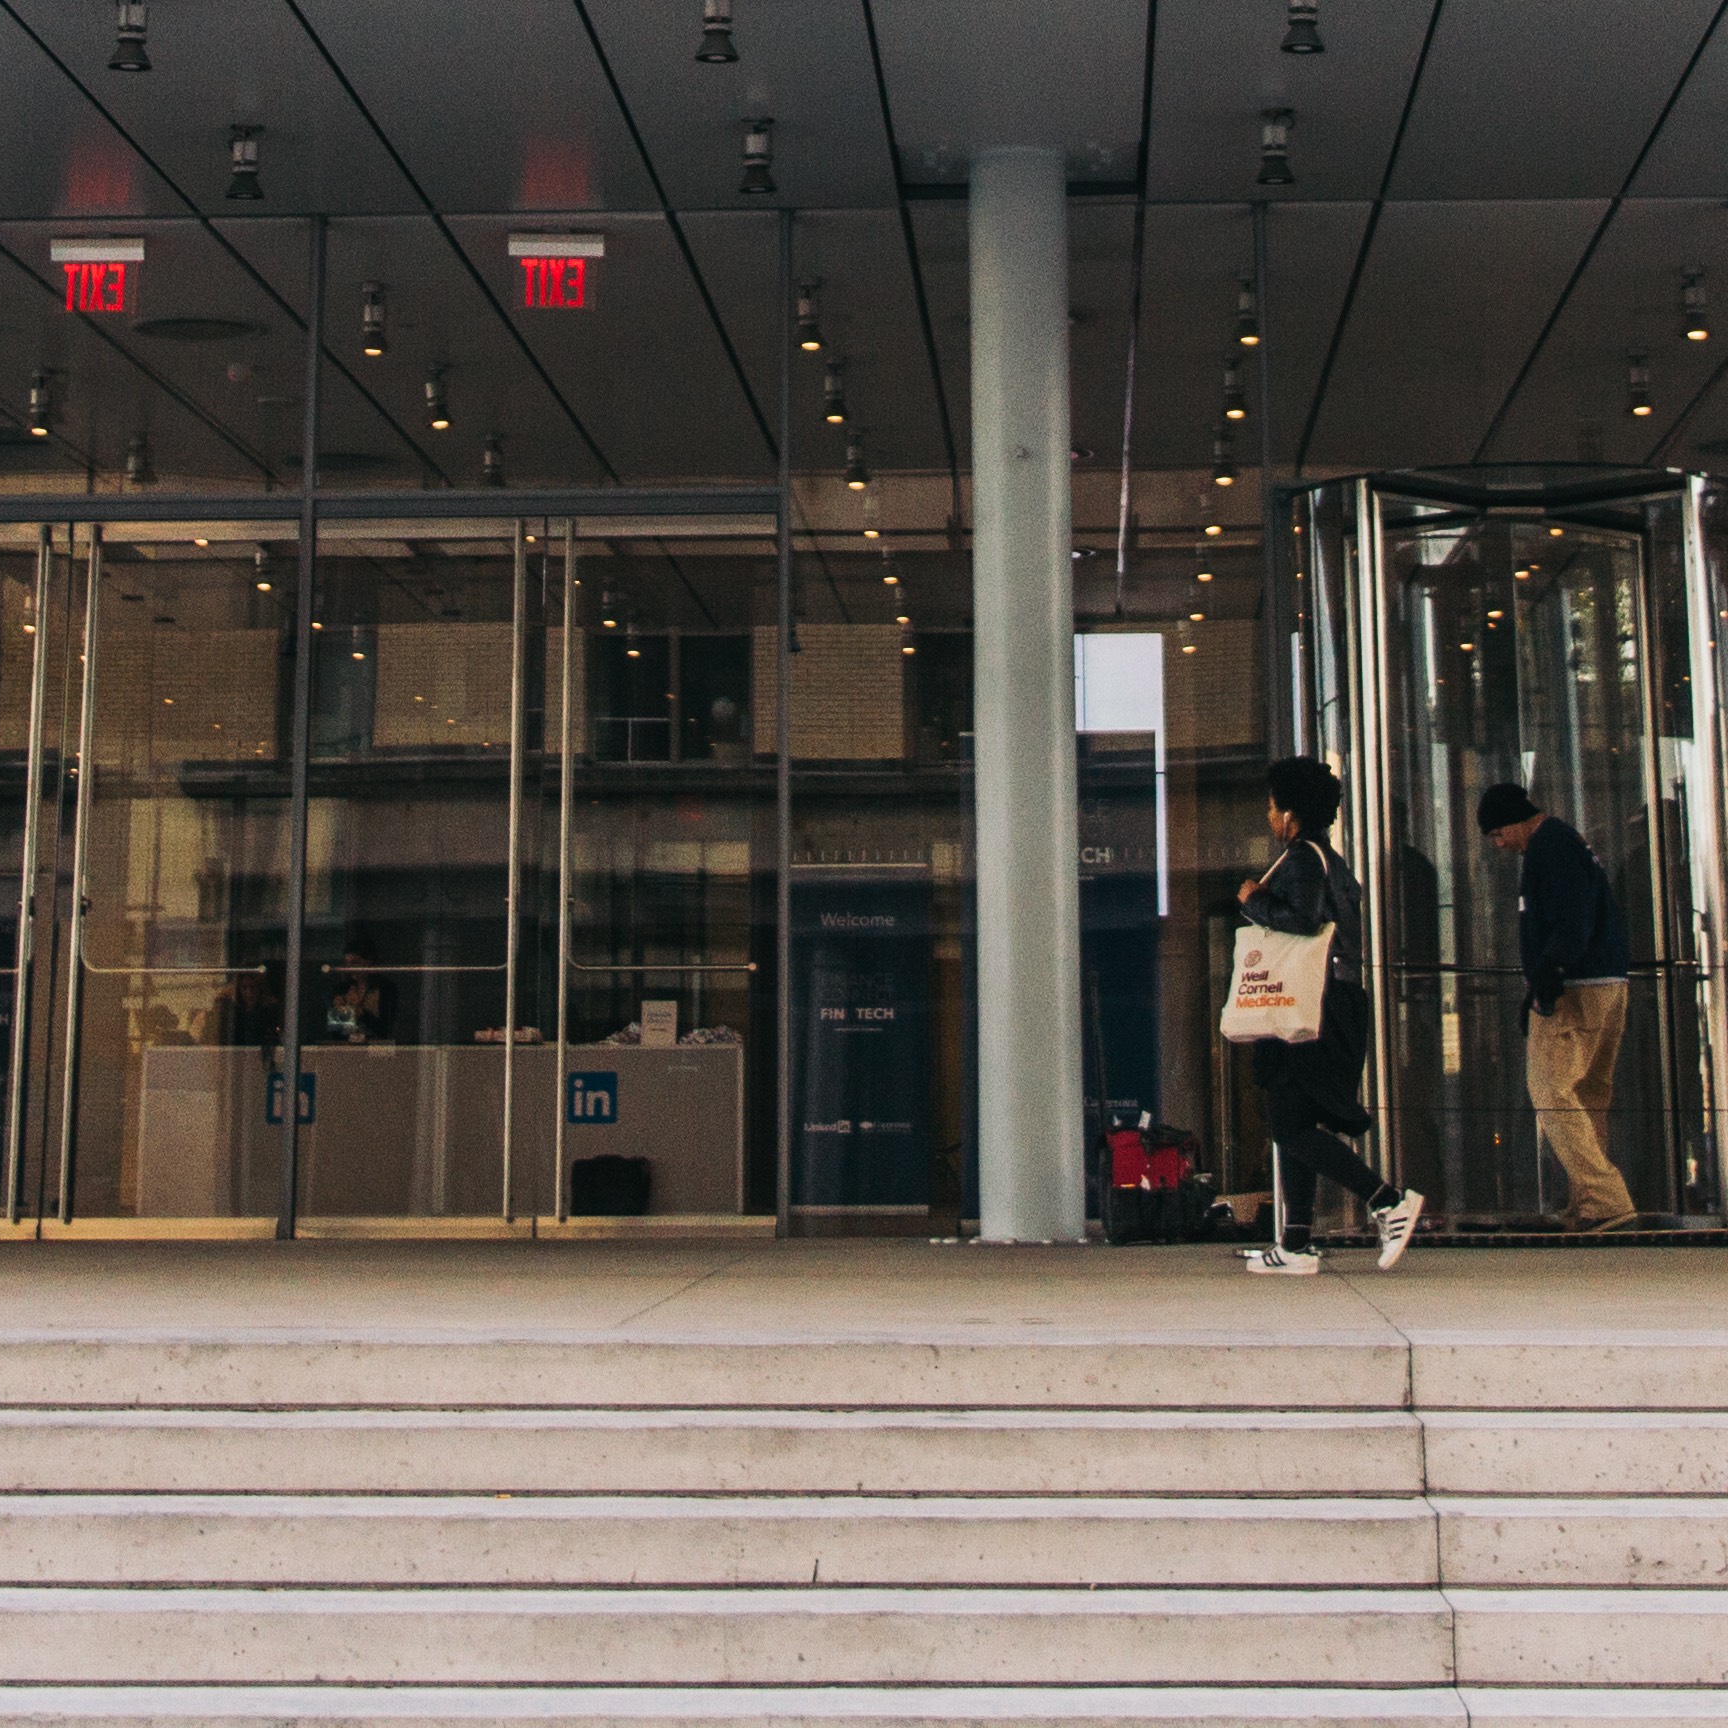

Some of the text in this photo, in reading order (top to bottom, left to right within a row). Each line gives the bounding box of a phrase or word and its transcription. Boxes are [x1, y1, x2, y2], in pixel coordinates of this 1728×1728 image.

[820, 911, 896, 927] Welcome
[1241, 969, 1270, 982] Weill
[1237, 980, 1284, 996] Cornell
[1235, 994, 1296, 1009] Medicine
[820, 1007, 895, 1020] FIN TECH
[574, 1078, 611, 1117] in
